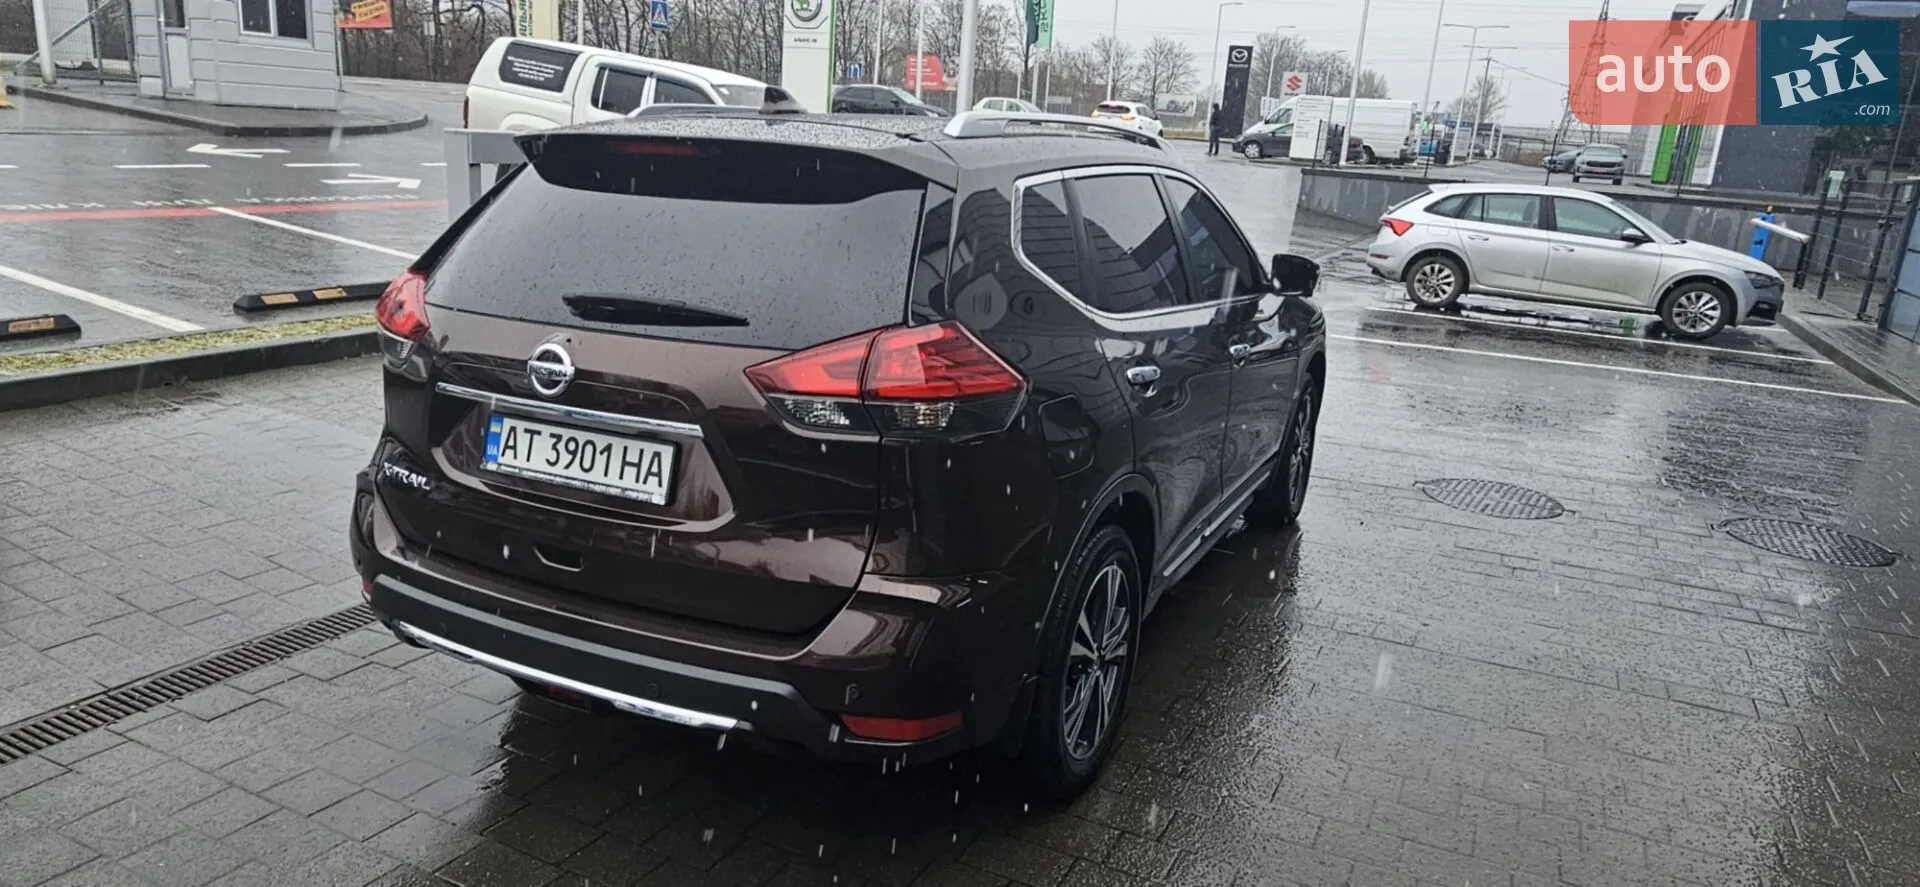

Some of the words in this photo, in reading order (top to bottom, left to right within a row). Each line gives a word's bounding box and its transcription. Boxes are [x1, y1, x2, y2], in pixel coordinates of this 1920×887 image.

[487, 443, 498, 456] UA
[501, 425, 542, 463] AT
[545, 432, 613, 478] 3901
[619, 445, 663, 488] HA
[383, 461, 430, 490] X-TRAIL
